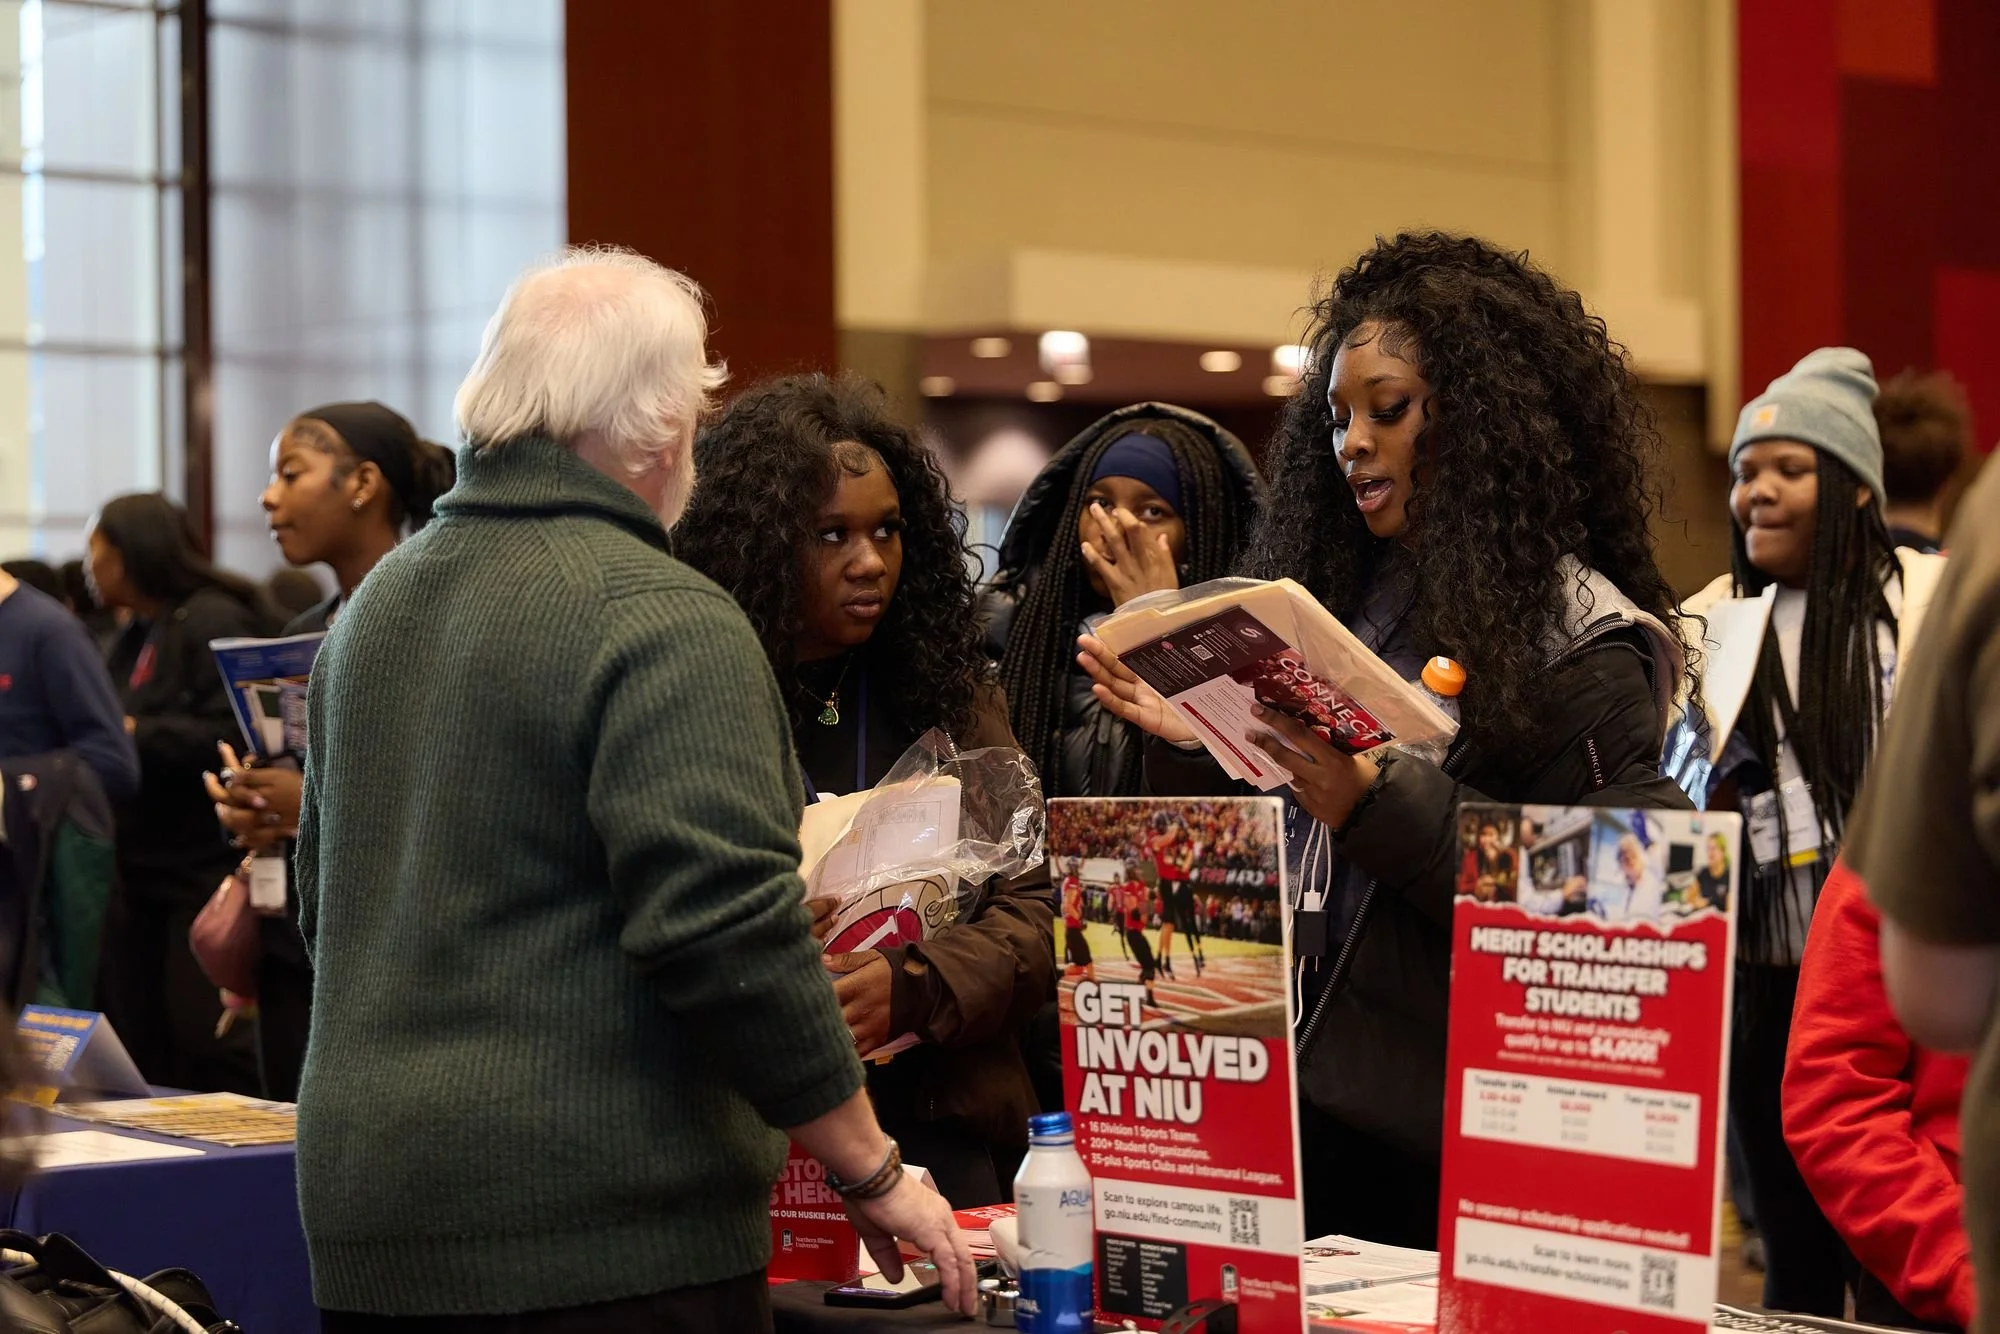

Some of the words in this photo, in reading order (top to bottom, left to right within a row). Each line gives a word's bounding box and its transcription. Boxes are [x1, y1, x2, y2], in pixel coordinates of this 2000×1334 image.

[1280, 657, 1381, 741] CONNECT
[1586, 738, 1604, 787] MONCLER
[1470, 926, 1534, 955] MERIT
[1536, 932, 1707, 969] SCHOLARSHIPS
[1503, 958, 1548, 984] FOR
[1550, 961, 1667, 996] TRANSFER
[1074, 981, 1147, 1026] GET
[1525, 987, 1640, 1021] STUDENTS
[1077, 1027, 1269, 1082] INVOLVED
[1079, 1073, 1127, 1116] AT
[1134, 1077, 1203, 1124] NIU
[1089, 1122, 1099, 1132] 16
[1100, 1123, 1133, 1137] Division
[1140, 1127, 1168, 1140] Sports
[1090, 1137, 1112, 1149] 200+
[1114, 1140, 1147, 1154] Student
[1123, 1158, 1151, 1172] Sports
[1152, 1160, 1176, 1173] Clubs
[1177, 1163, 1194, 1174] and
[780, 1210, 797, 1218] OUR
[798, 1211, 825, 1220] HUSKIE
[826, 1212, 848, 1221] PACK.
[1104, 1191, 1124, 1205] Scan
[1126, 1194, 1135, 1205] to
[1137, 1195, 1168, 1211] explore
[1171, 1200, 1204, 1214] campus
[1207, 1202, 1223, 1216] life.
[1104, 1209, 1222, 1233] go.niu.edu/find-community
[795, 1236, 816, 1244] Northern
[817, 1237, 834, 1245] Illinois
[795, 1242, 819, 1250] University
